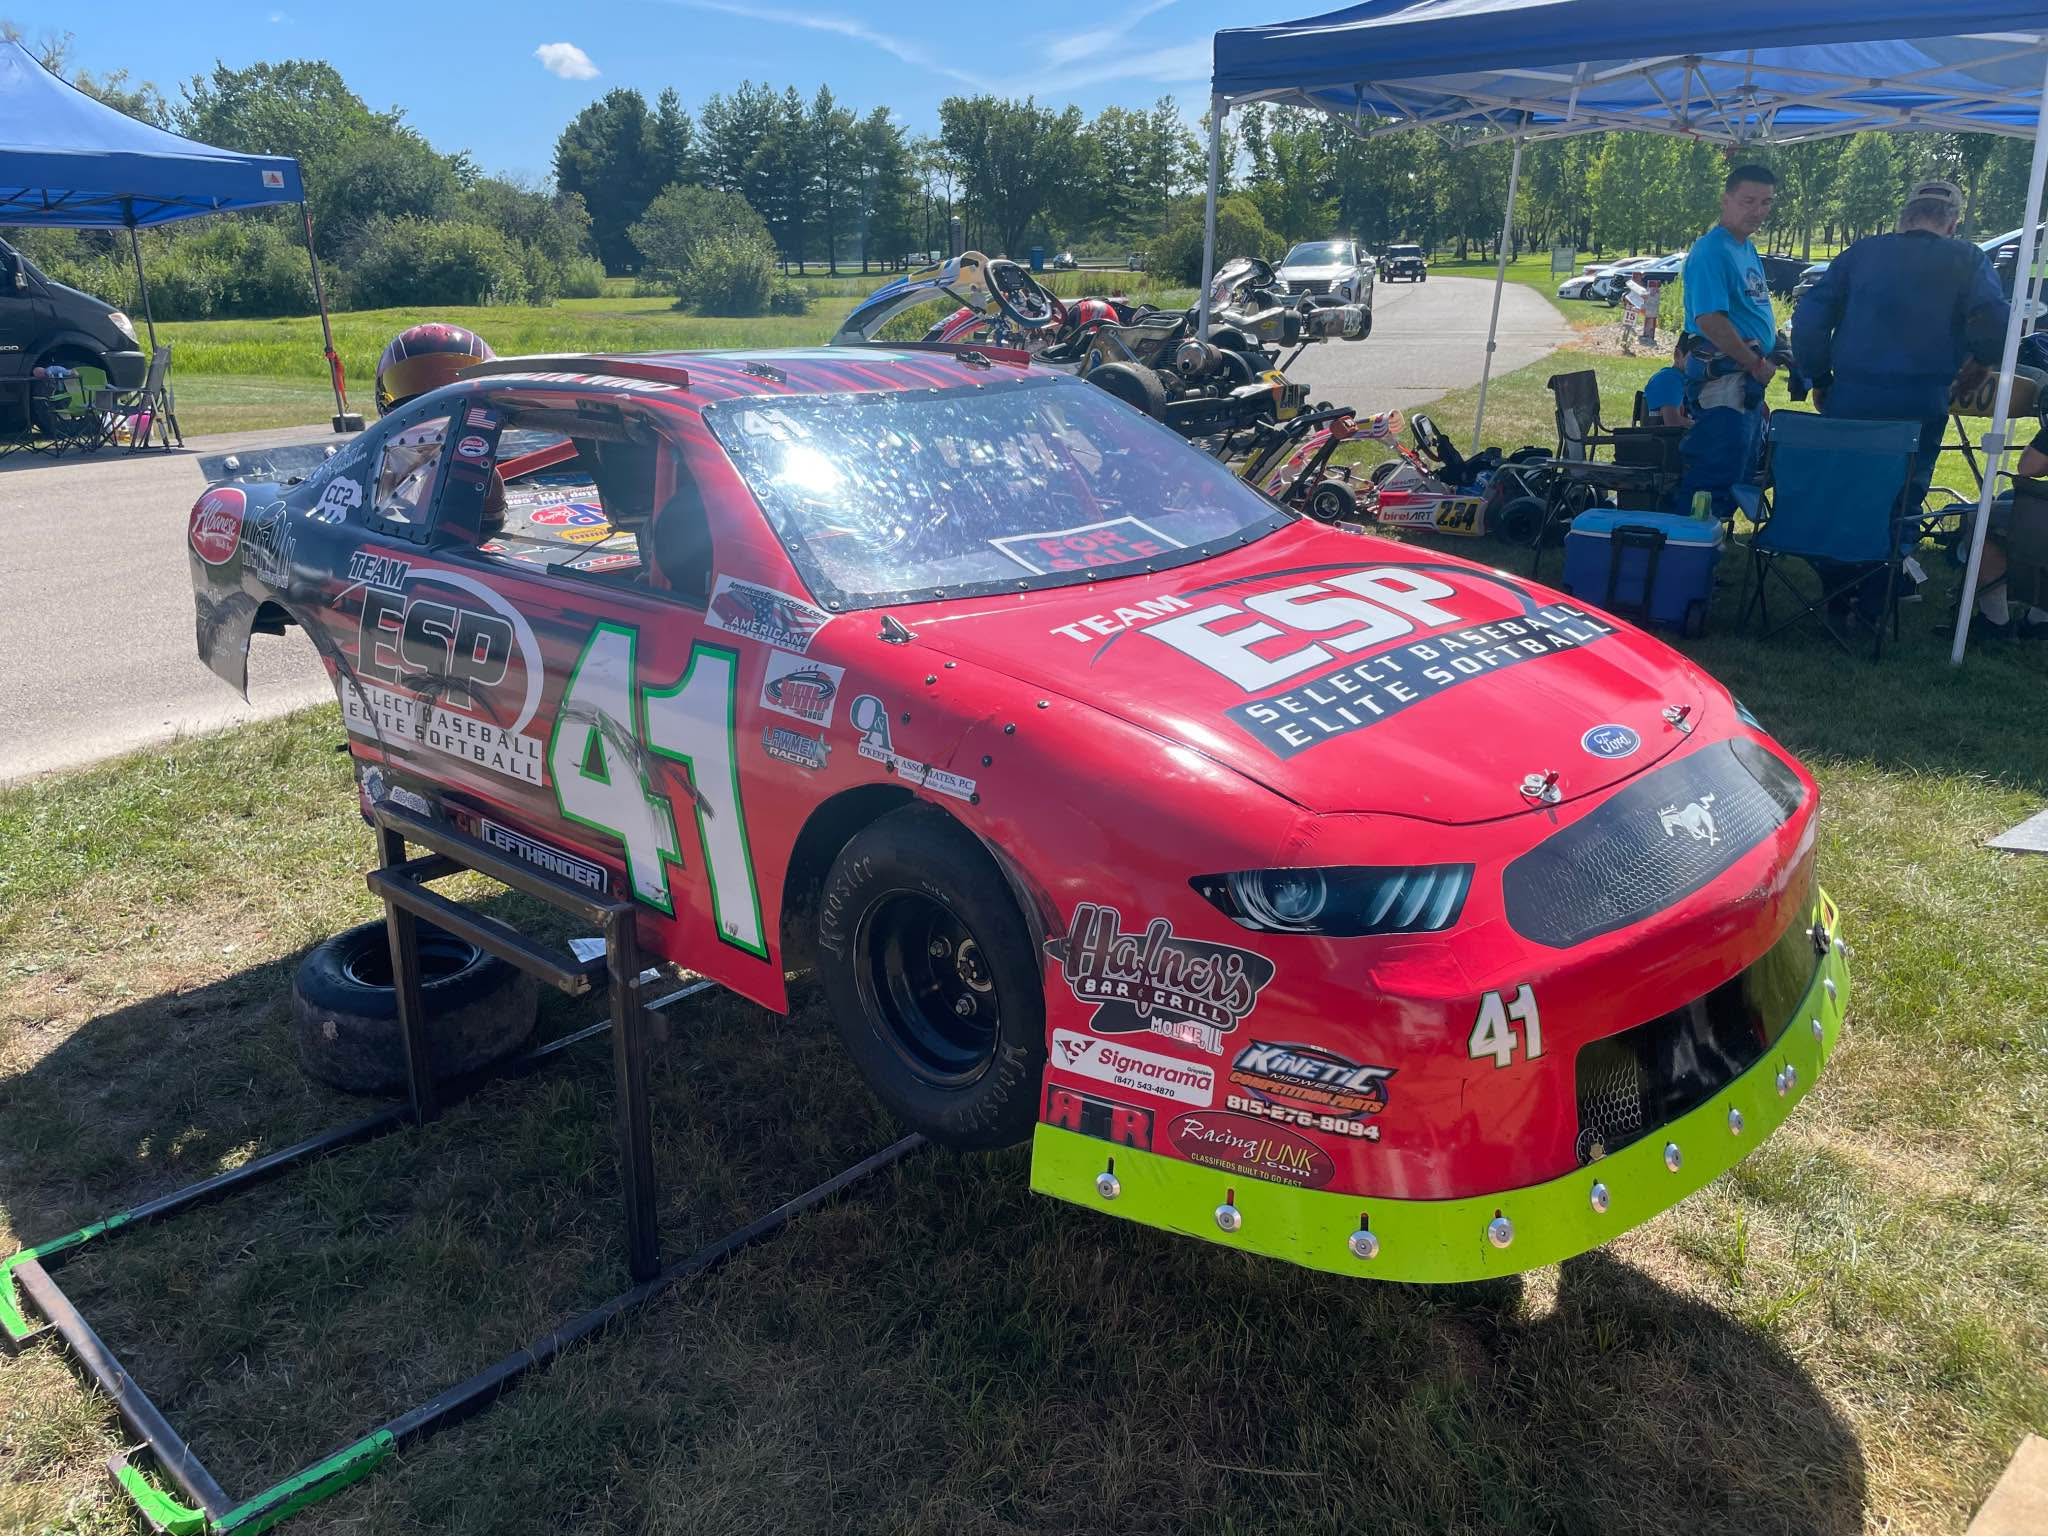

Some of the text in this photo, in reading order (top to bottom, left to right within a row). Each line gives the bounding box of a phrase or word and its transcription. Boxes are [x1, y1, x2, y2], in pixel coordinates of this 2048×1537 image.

[1624, 311, 1636, 322] 15
[192, 498, 237, 536] Albanese
[325, 485, 354, 507] CC2
[1437, 501, 1478, 530] 234
[1038, 529, 1129, 557] FOR
[1051, 541, 1161, 570] SALE
[348, 551, 411, 590] TEAM
[731, 616, 804, 646] AMERICAN
[1050, 594, 1193, 643] TEAM
[1140, 567, 1465, 693] ESP
[357, 587, 513, 711] ESP
[1245, 604, 1586, 724] SELECT BASEBALL
[1275, 620, 1614, 747] ELITE SOFTBALL
[349, 702, 537, 781] ELITE SOFTBALL
[422, 704, 539, 760] BASEBALL
[763, 726, 818, 760] LAWMEN
[1593, 731, 1632, 754] Ford
[860, 745, 891, 762] O'KEEFE
[901, 759, 956, 787] ASSOIATES,
[548, 618, 771, 965] 41
[485, 827, 602, 890] LEFTHANDER
[1084, 978, 1129, 997] BAR
[1153, 991, 1222, 1022] GRILL
[1467, 982, 1543, 1069] 41
[1098, 1047, 1212, 1091] Signarama
[1114, 1074, 1175, 1098] (847) 543-4870
[1270, 1073, 1355, 1096] MIDWEST
[1229, 1071, 1385, 1113] COMPETITION PARTS
[1226, 1095, 1380, 1141] 815-276-9094
[1191, 1152, 1302, 1187] CLASSIFIEDS BUILT TO GO FAST
[1261, 1162, 1310, 1177] .com
